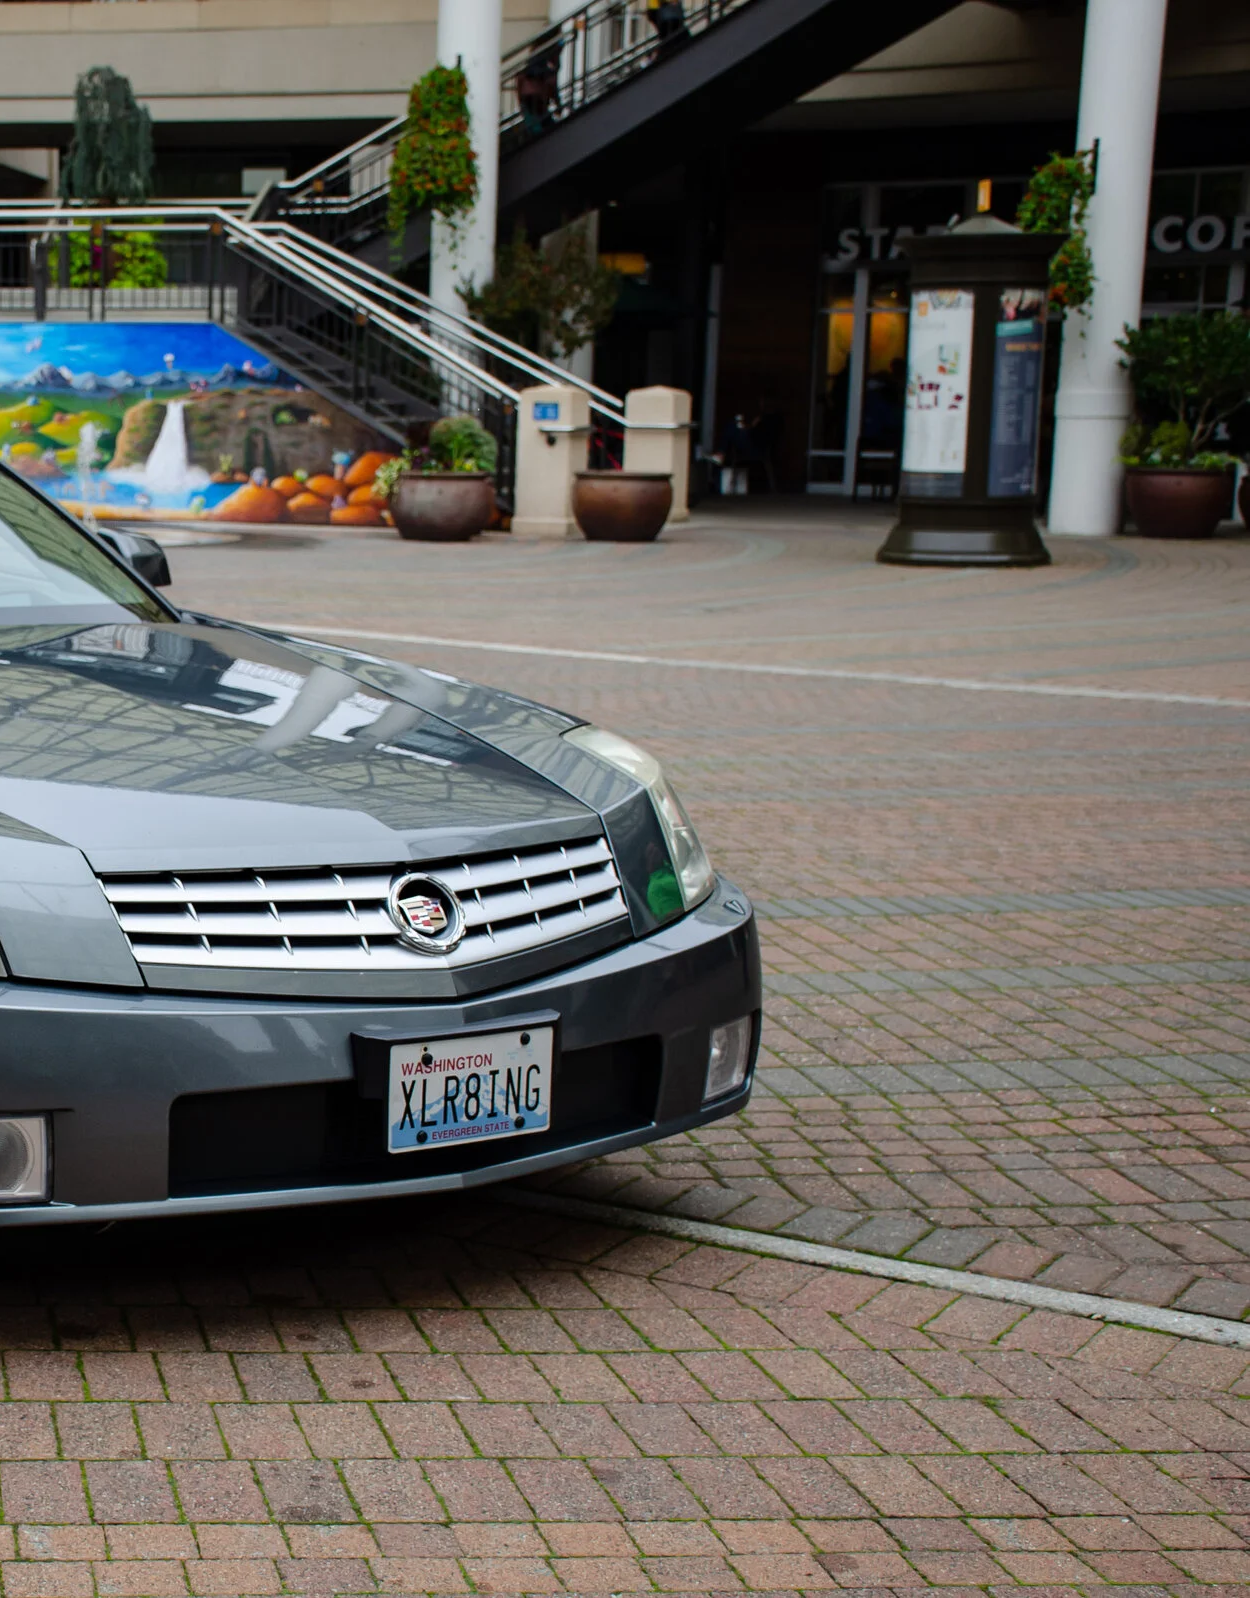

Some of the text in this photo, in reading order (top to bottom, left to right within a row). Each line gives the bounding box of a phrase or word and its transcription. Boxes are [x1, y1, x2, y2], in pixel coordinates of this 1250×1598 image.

[401, 1053, 493, 1076] WASHINGTON
[399, 1064, 541, 1130] XLR8ING
[432, 1121, 510, 1140] EVERGREEN STATE
